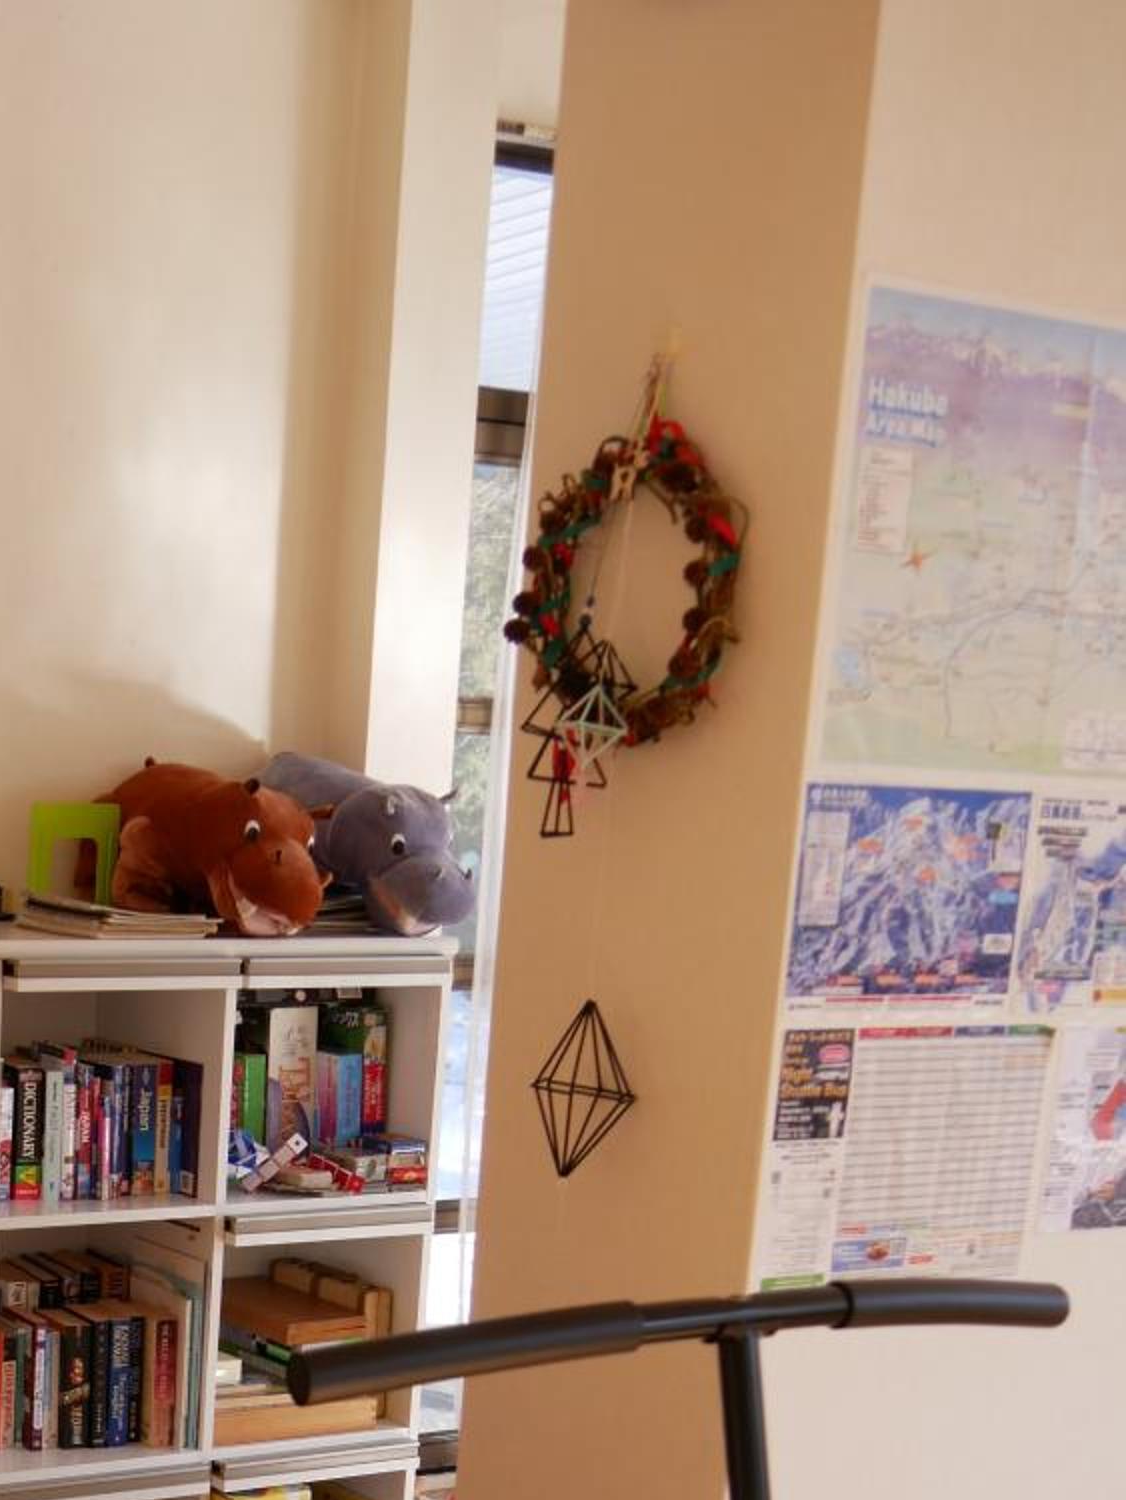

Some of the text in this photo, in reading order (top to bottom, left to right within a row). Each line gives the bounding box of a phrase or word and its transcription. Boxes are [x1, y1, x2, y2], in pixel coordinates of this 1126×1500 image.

[868, 378, 949, 416] Hakuba
[23, 1081, 37, 1158] DICTIONARY
[138, 1087, 152, 1131] Japan
